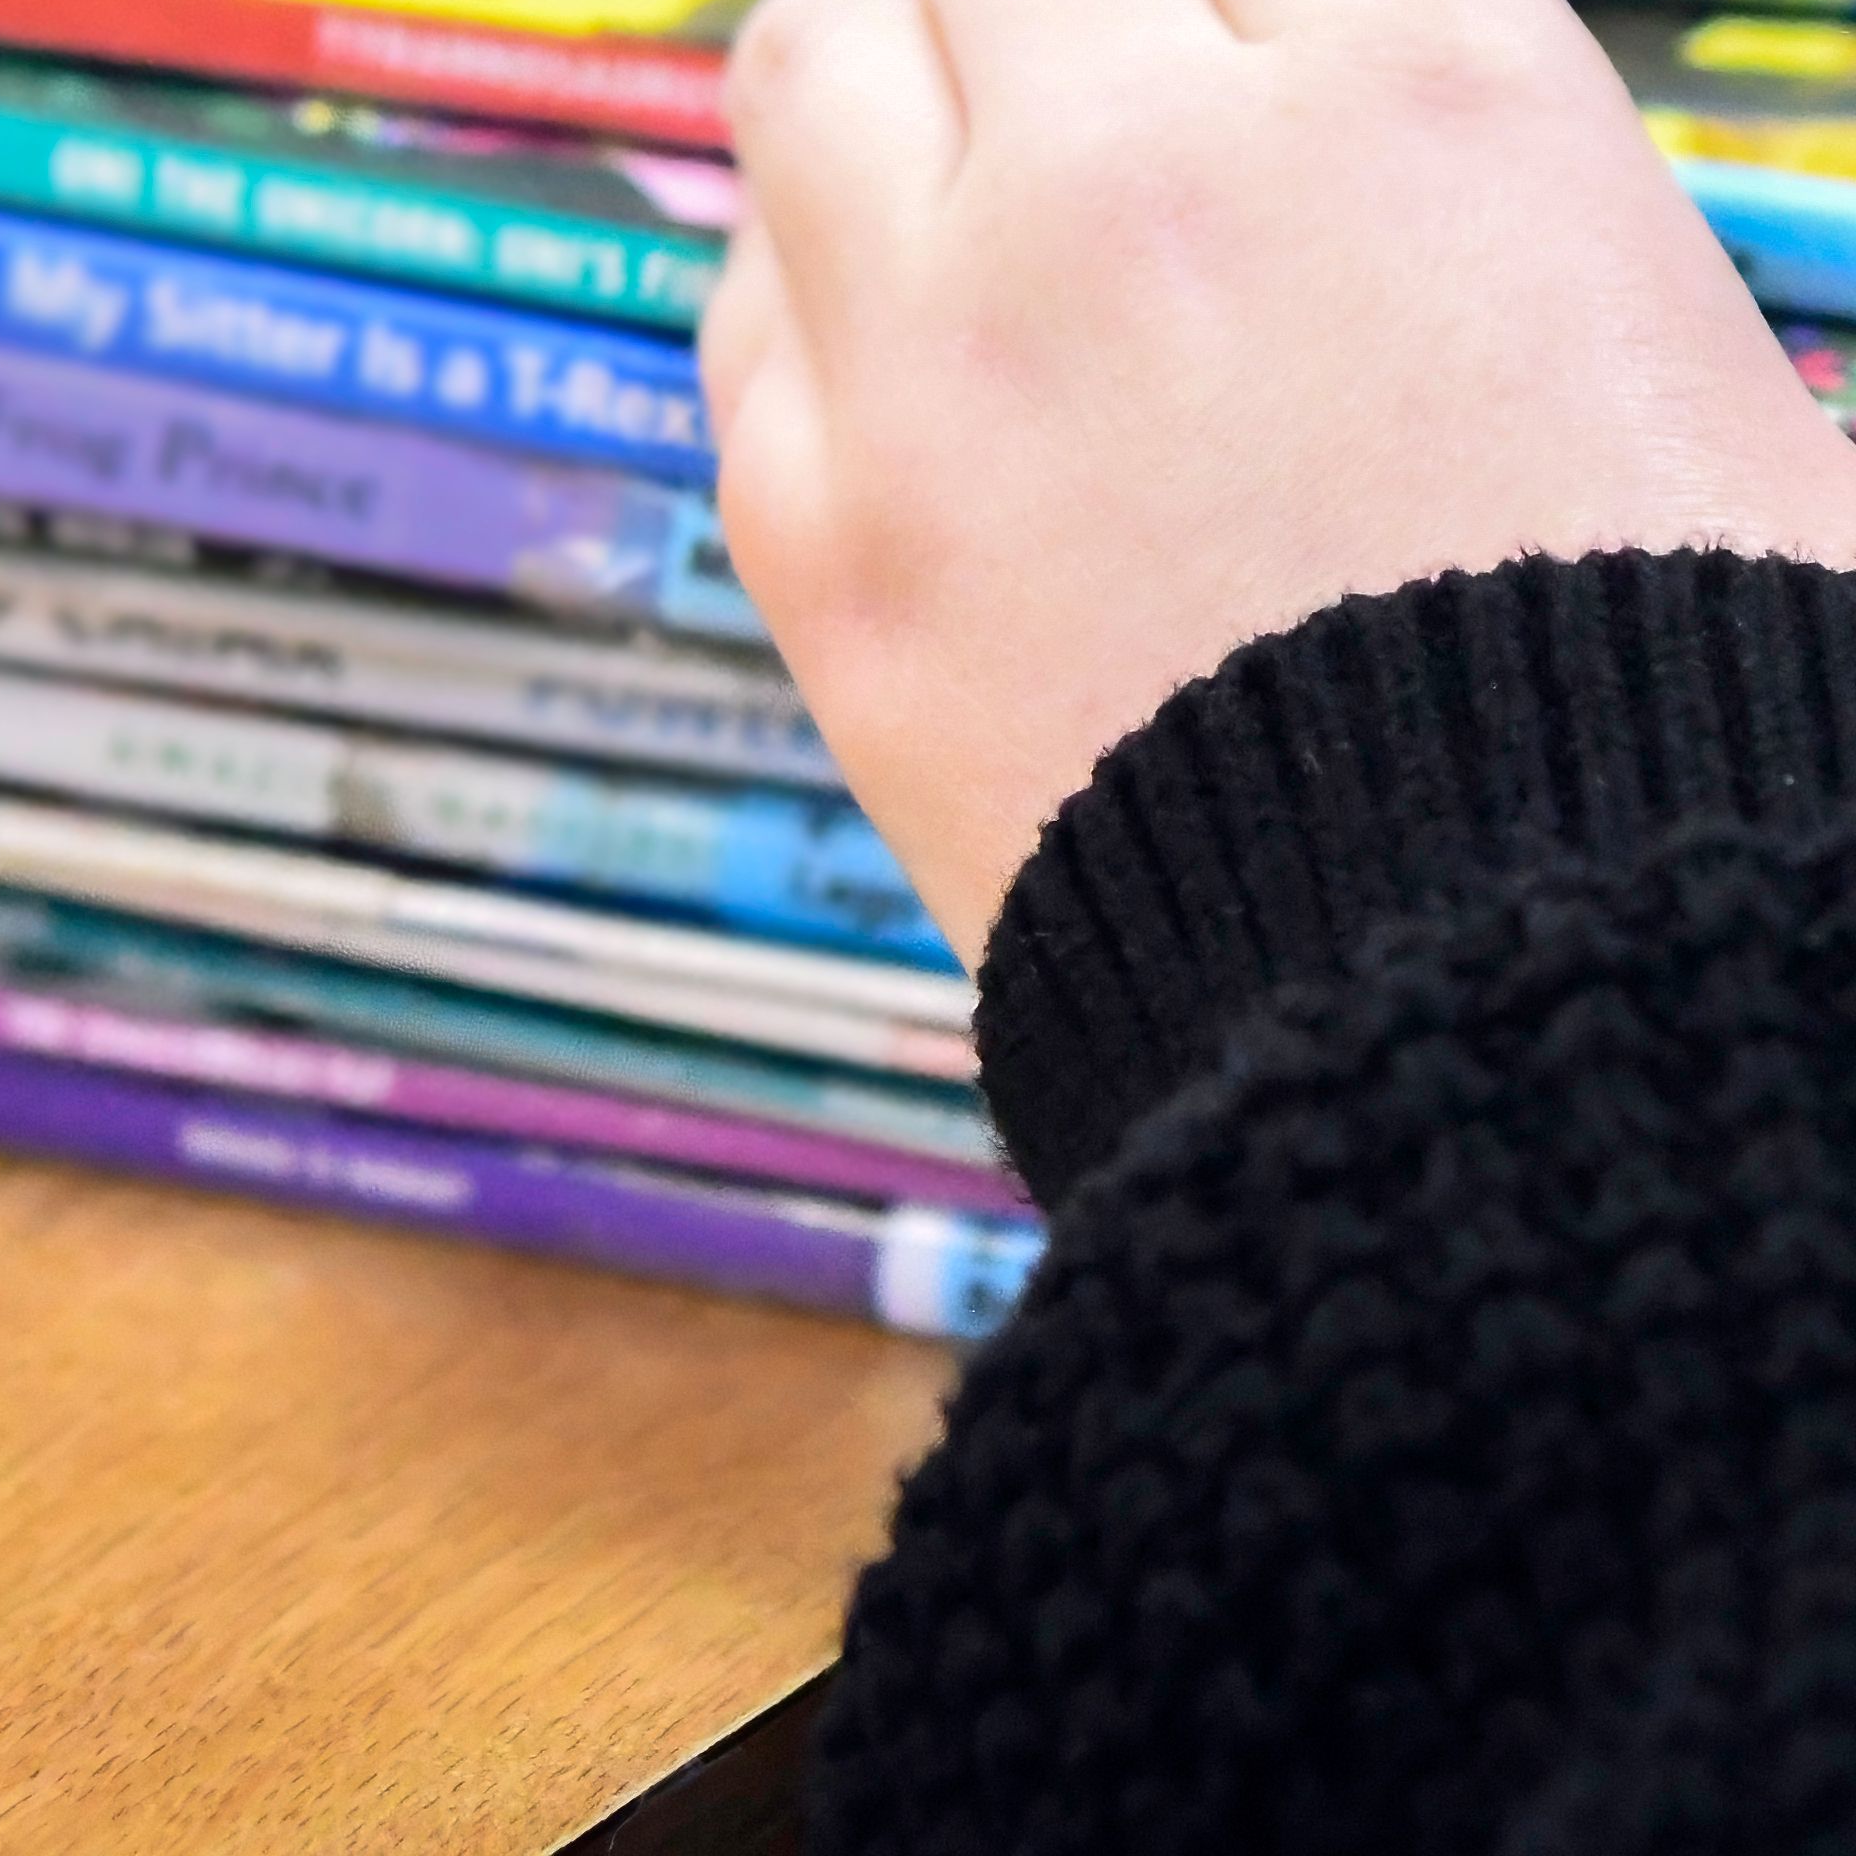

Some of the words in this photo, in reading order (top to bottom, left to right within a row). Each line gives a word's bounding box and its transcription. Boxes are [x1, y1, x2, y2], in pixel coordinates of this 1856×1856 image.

[6, 246, 131, 350] My
[144, 268, 341, 382] Sitter
[436, 344, 491, 406] a
[157, 408, 381, 525] Prince
